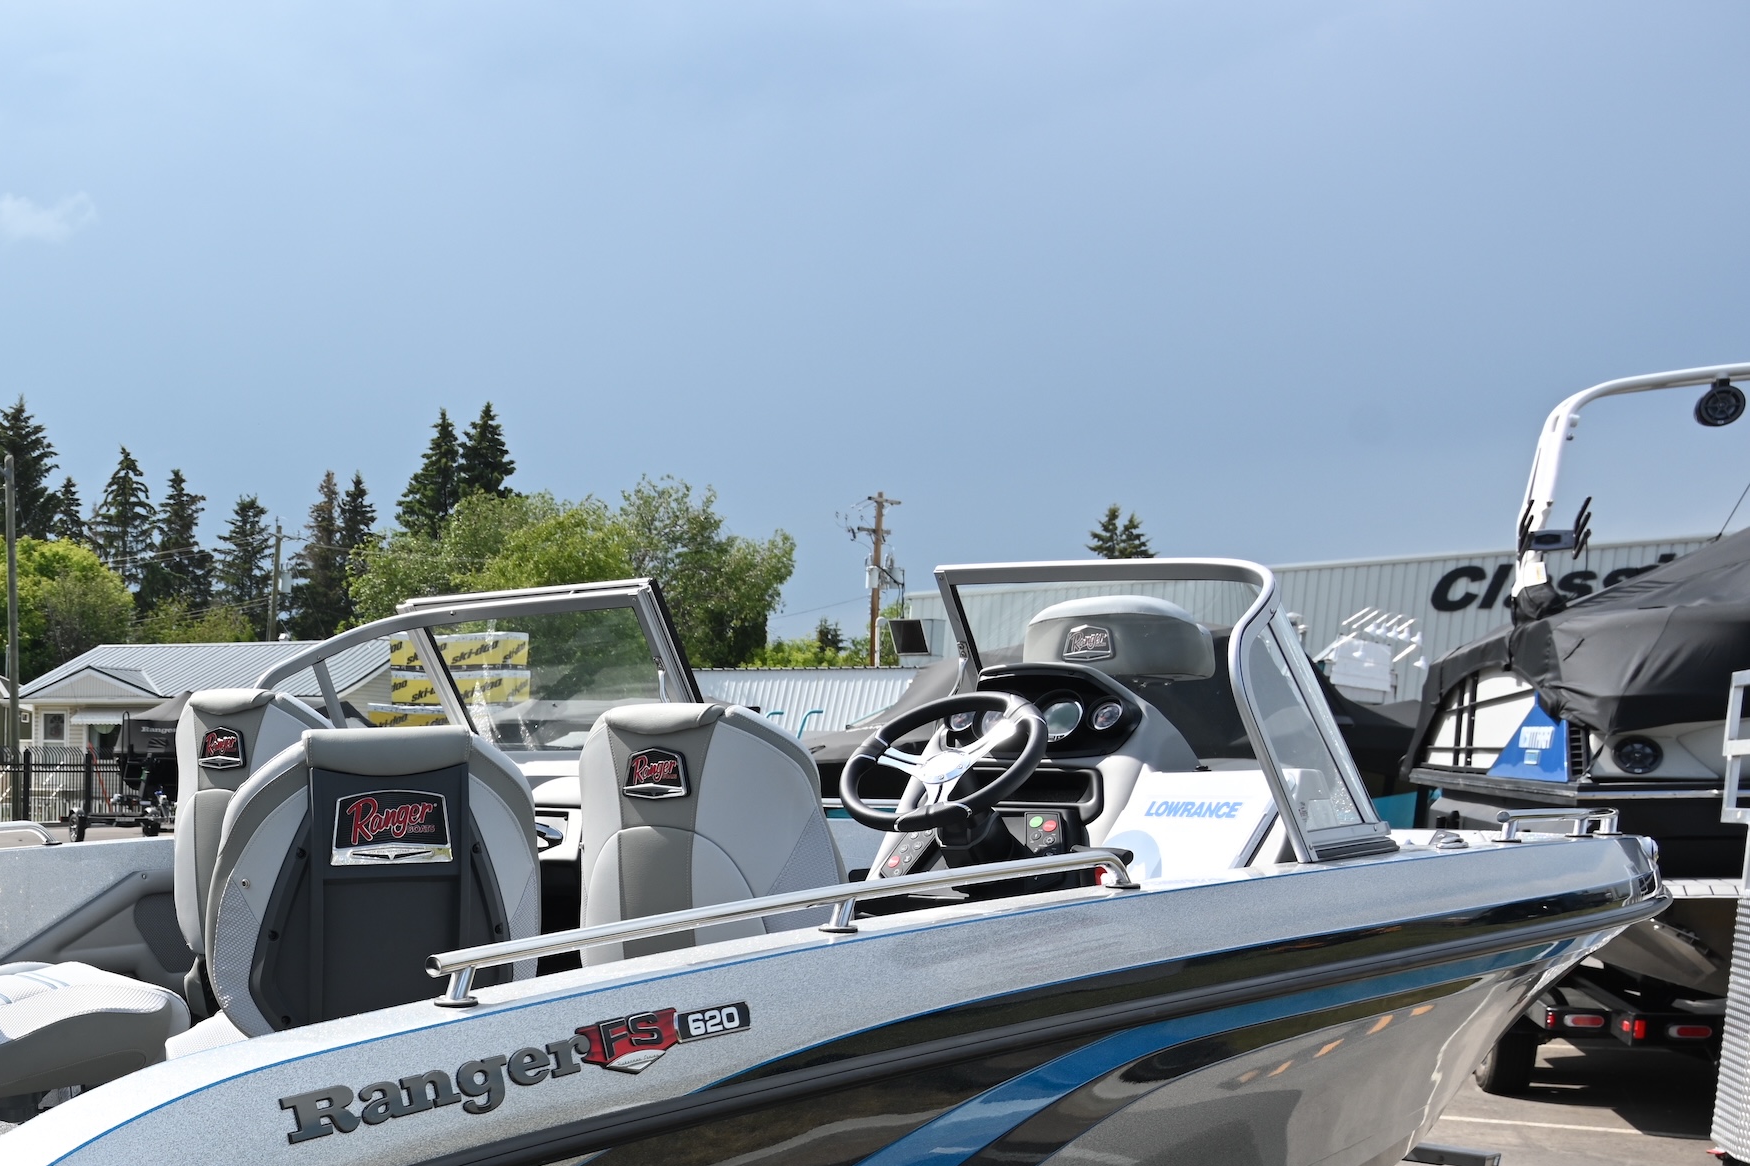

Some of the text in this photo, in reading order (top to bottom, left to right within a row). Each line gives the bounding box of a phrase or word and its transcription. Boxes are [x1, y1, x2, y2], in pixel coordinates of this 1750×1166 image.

[451, 640, 500, 665] ski-doo
[205, 732, 238, 757] Ranger
[631, 754, 678, 786] Ranger
[346, 797, 434, 845] Ranger
[1144, 800, 1244, 819] LOWRANCE
[406, 825, 436, 833] BOATS
[280, 1006, 740, 1145] Ranger FS 620
